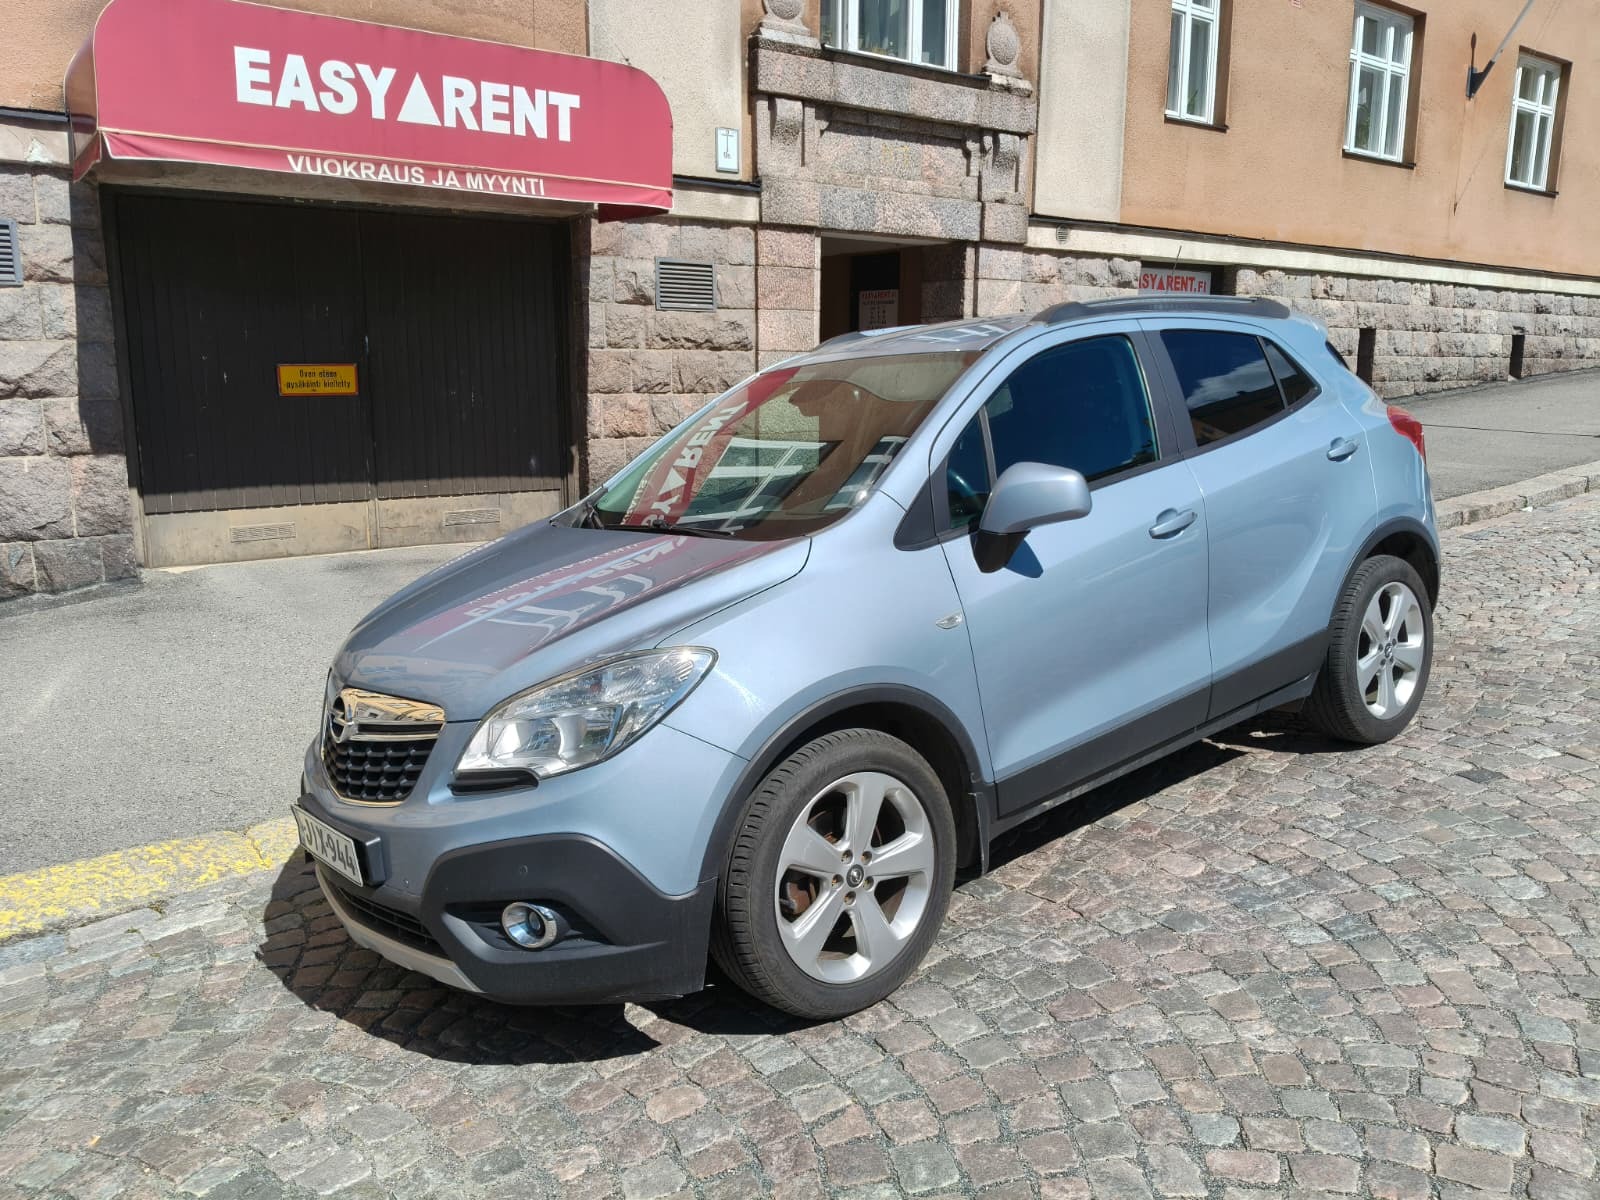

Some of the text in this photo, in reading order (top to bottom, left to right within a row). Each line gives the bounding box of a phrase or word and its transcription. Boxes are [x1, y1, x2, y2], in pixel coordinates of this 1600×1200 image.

[287, 154, 545, 196] VUOKRAUS JA MYYNTI
[299, 369, 316, 378] Oven
